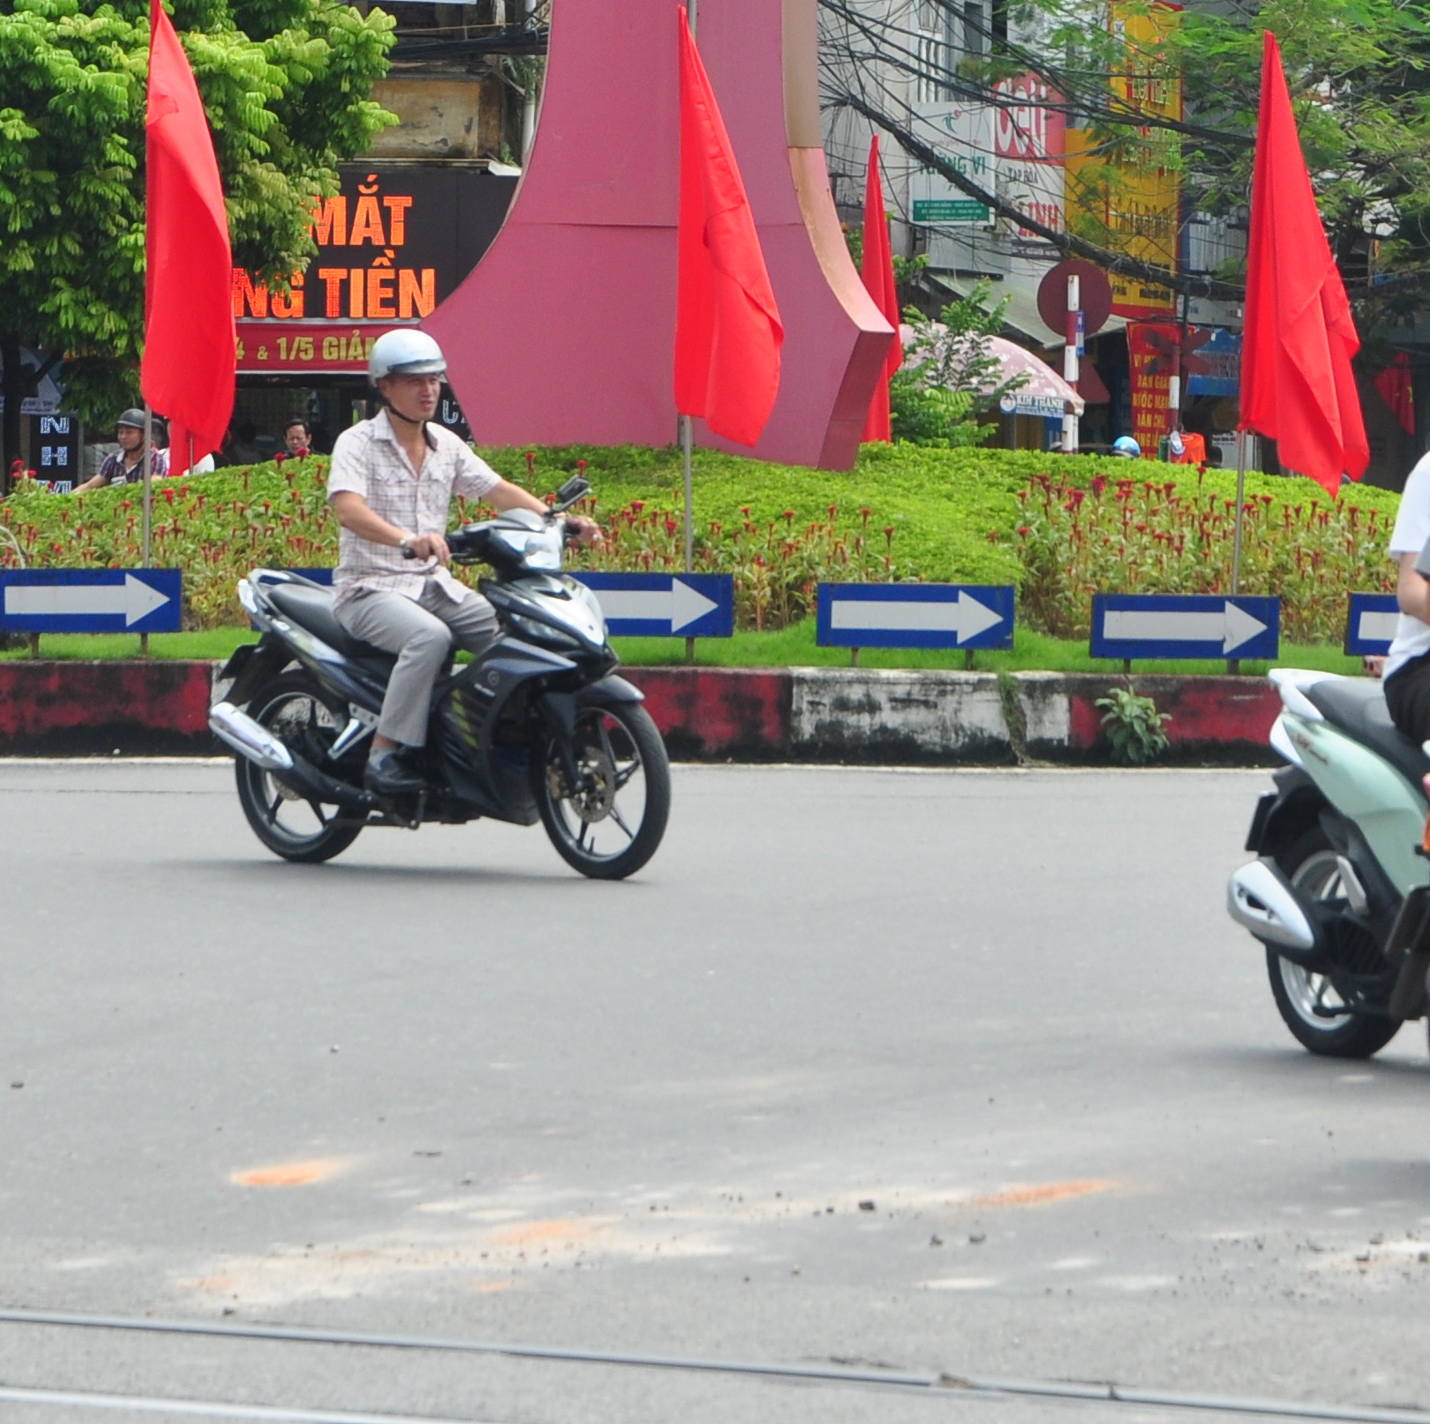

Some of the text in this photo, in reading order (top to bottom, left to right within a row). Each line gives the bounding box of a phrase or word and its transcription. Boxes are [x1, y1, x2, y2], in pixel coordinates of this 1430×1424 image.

[309, 174, 413, 246] MẮT
[318, 249, 435, 318] TIỀN
[257, 346, 268, 360] &
[276, 337, 314, 361] 1/5
